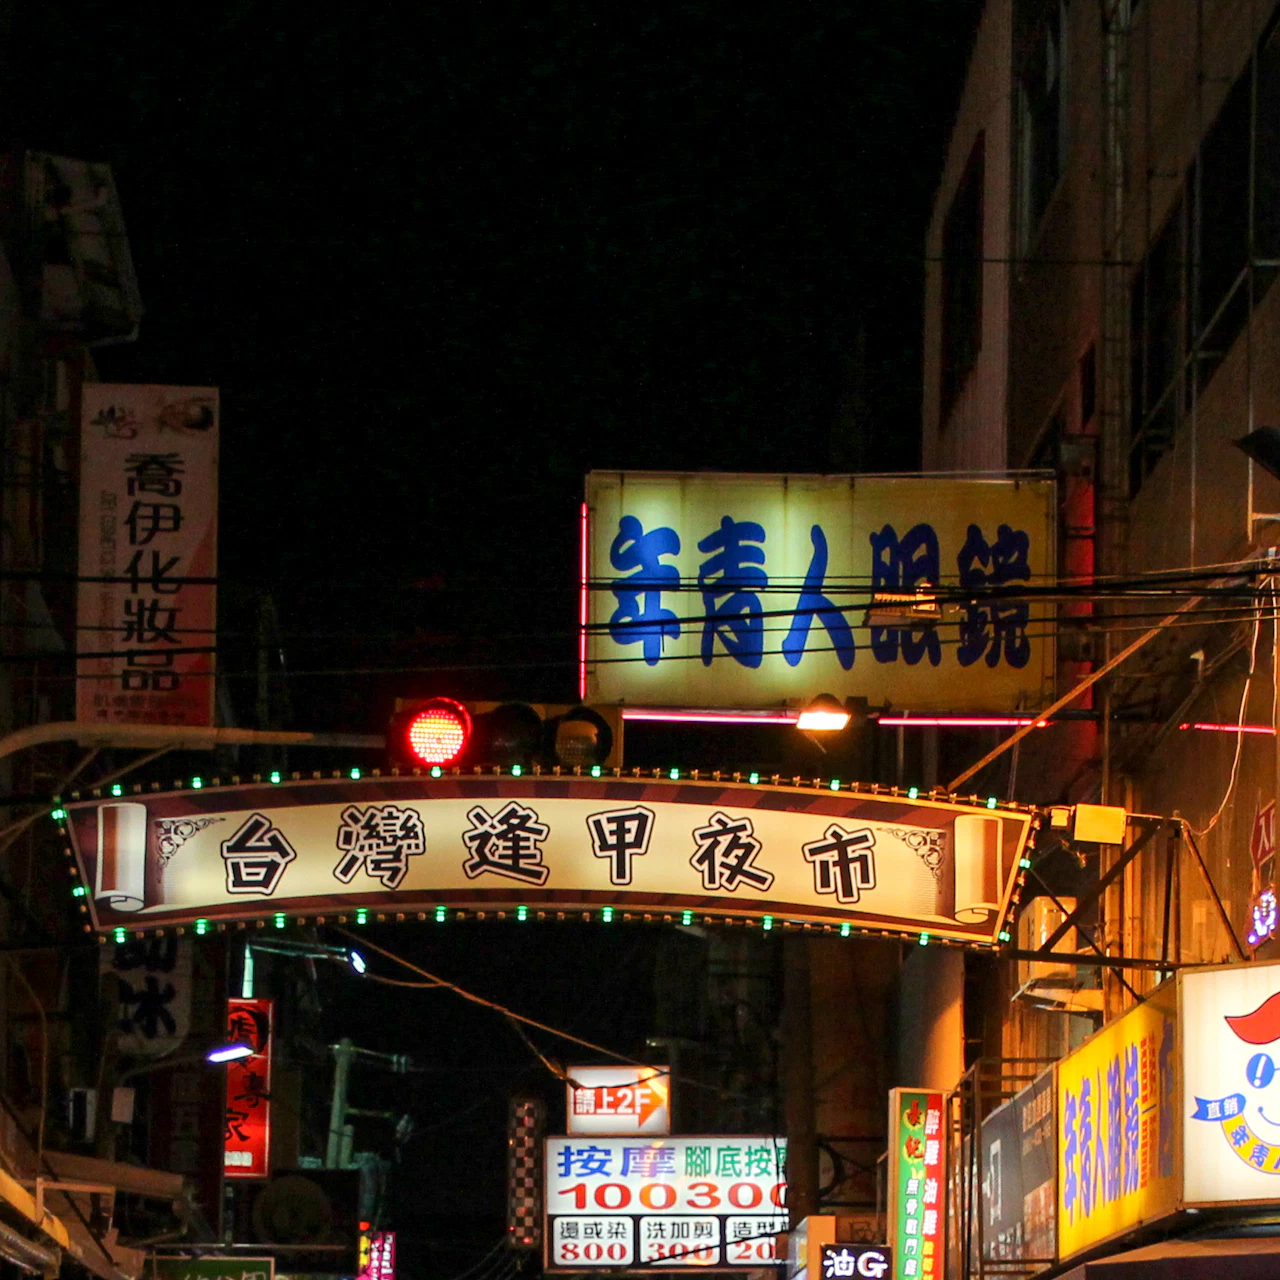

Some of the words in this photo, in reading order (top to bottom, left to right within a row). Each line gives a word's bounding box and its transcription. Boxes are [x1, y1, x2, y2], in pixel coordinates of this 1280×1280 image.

[122, 452, 186, 691] 喬伊化妝品
[608, 514, 1032, 671] 年青人眼鏡
[219, 799, 880, 906] 台灣逢甲夜市
[574, 1086, 652, 1115] 請上2F
[1206, 1096, 1239, 1120] 直銷
[557, 1145, 676, 1178] 按摩
[557, 1182, 678, 1211] 100
[559, 1221, 628, 1240] 燙或染
[646, 1221, 714, 1239] 洗加剪
[560, 1242, 627, 1261] 800
[646, 1242, 714, 1262] 300
[822, 1248, 888, 1279] 油G
